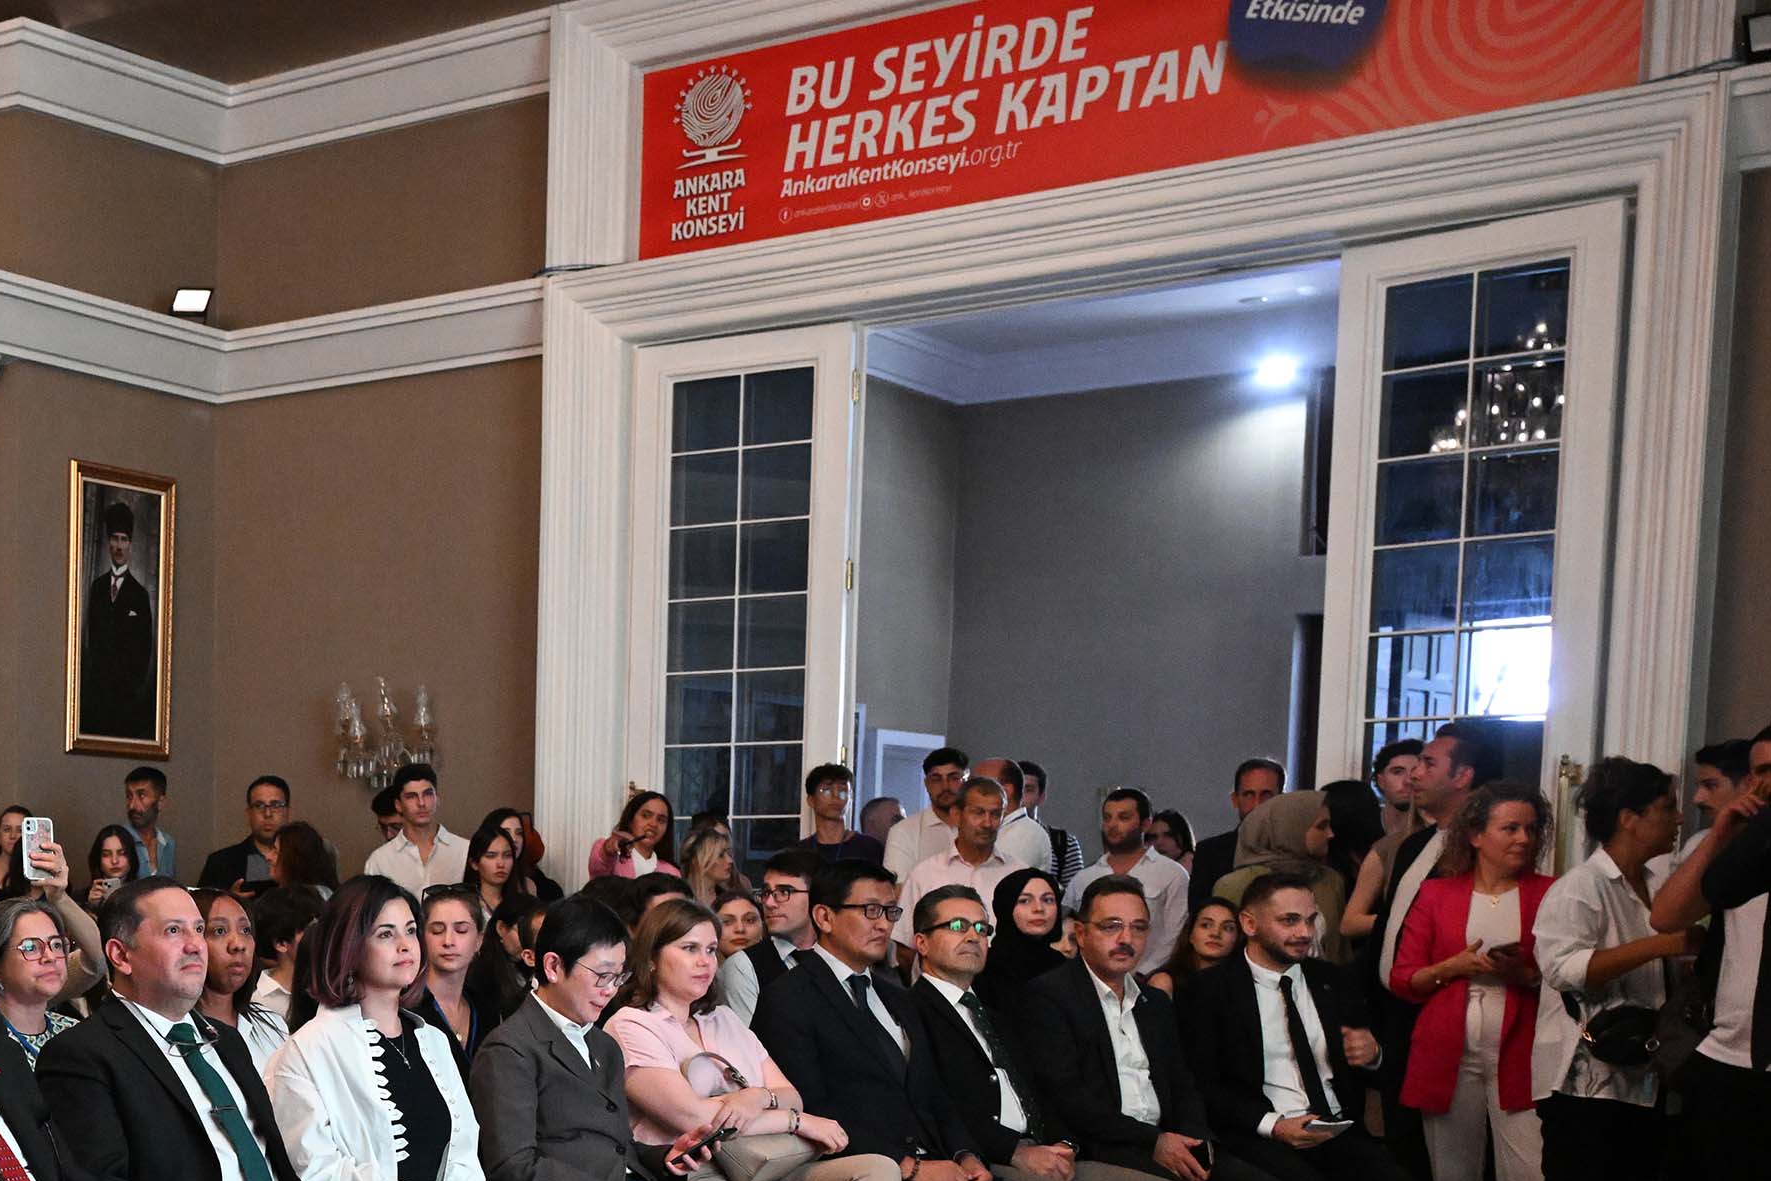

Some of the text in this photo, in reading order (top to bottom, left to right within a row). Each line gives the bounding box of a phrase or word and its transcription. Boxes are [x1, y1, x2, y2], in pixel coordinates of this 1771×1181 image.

[785, 7, 1094, 117] BU SEYİRDE
[783, 41, 1227, 173] HERKES KAPTAN
[673, 168, 746, 199] ANKARA
[780, 141, 1023, 198] AnkaraKentKonseyi.org.tr
[671, 206, 745, 241] KONSEYİ
[686, 191, 732, 218] KENT
